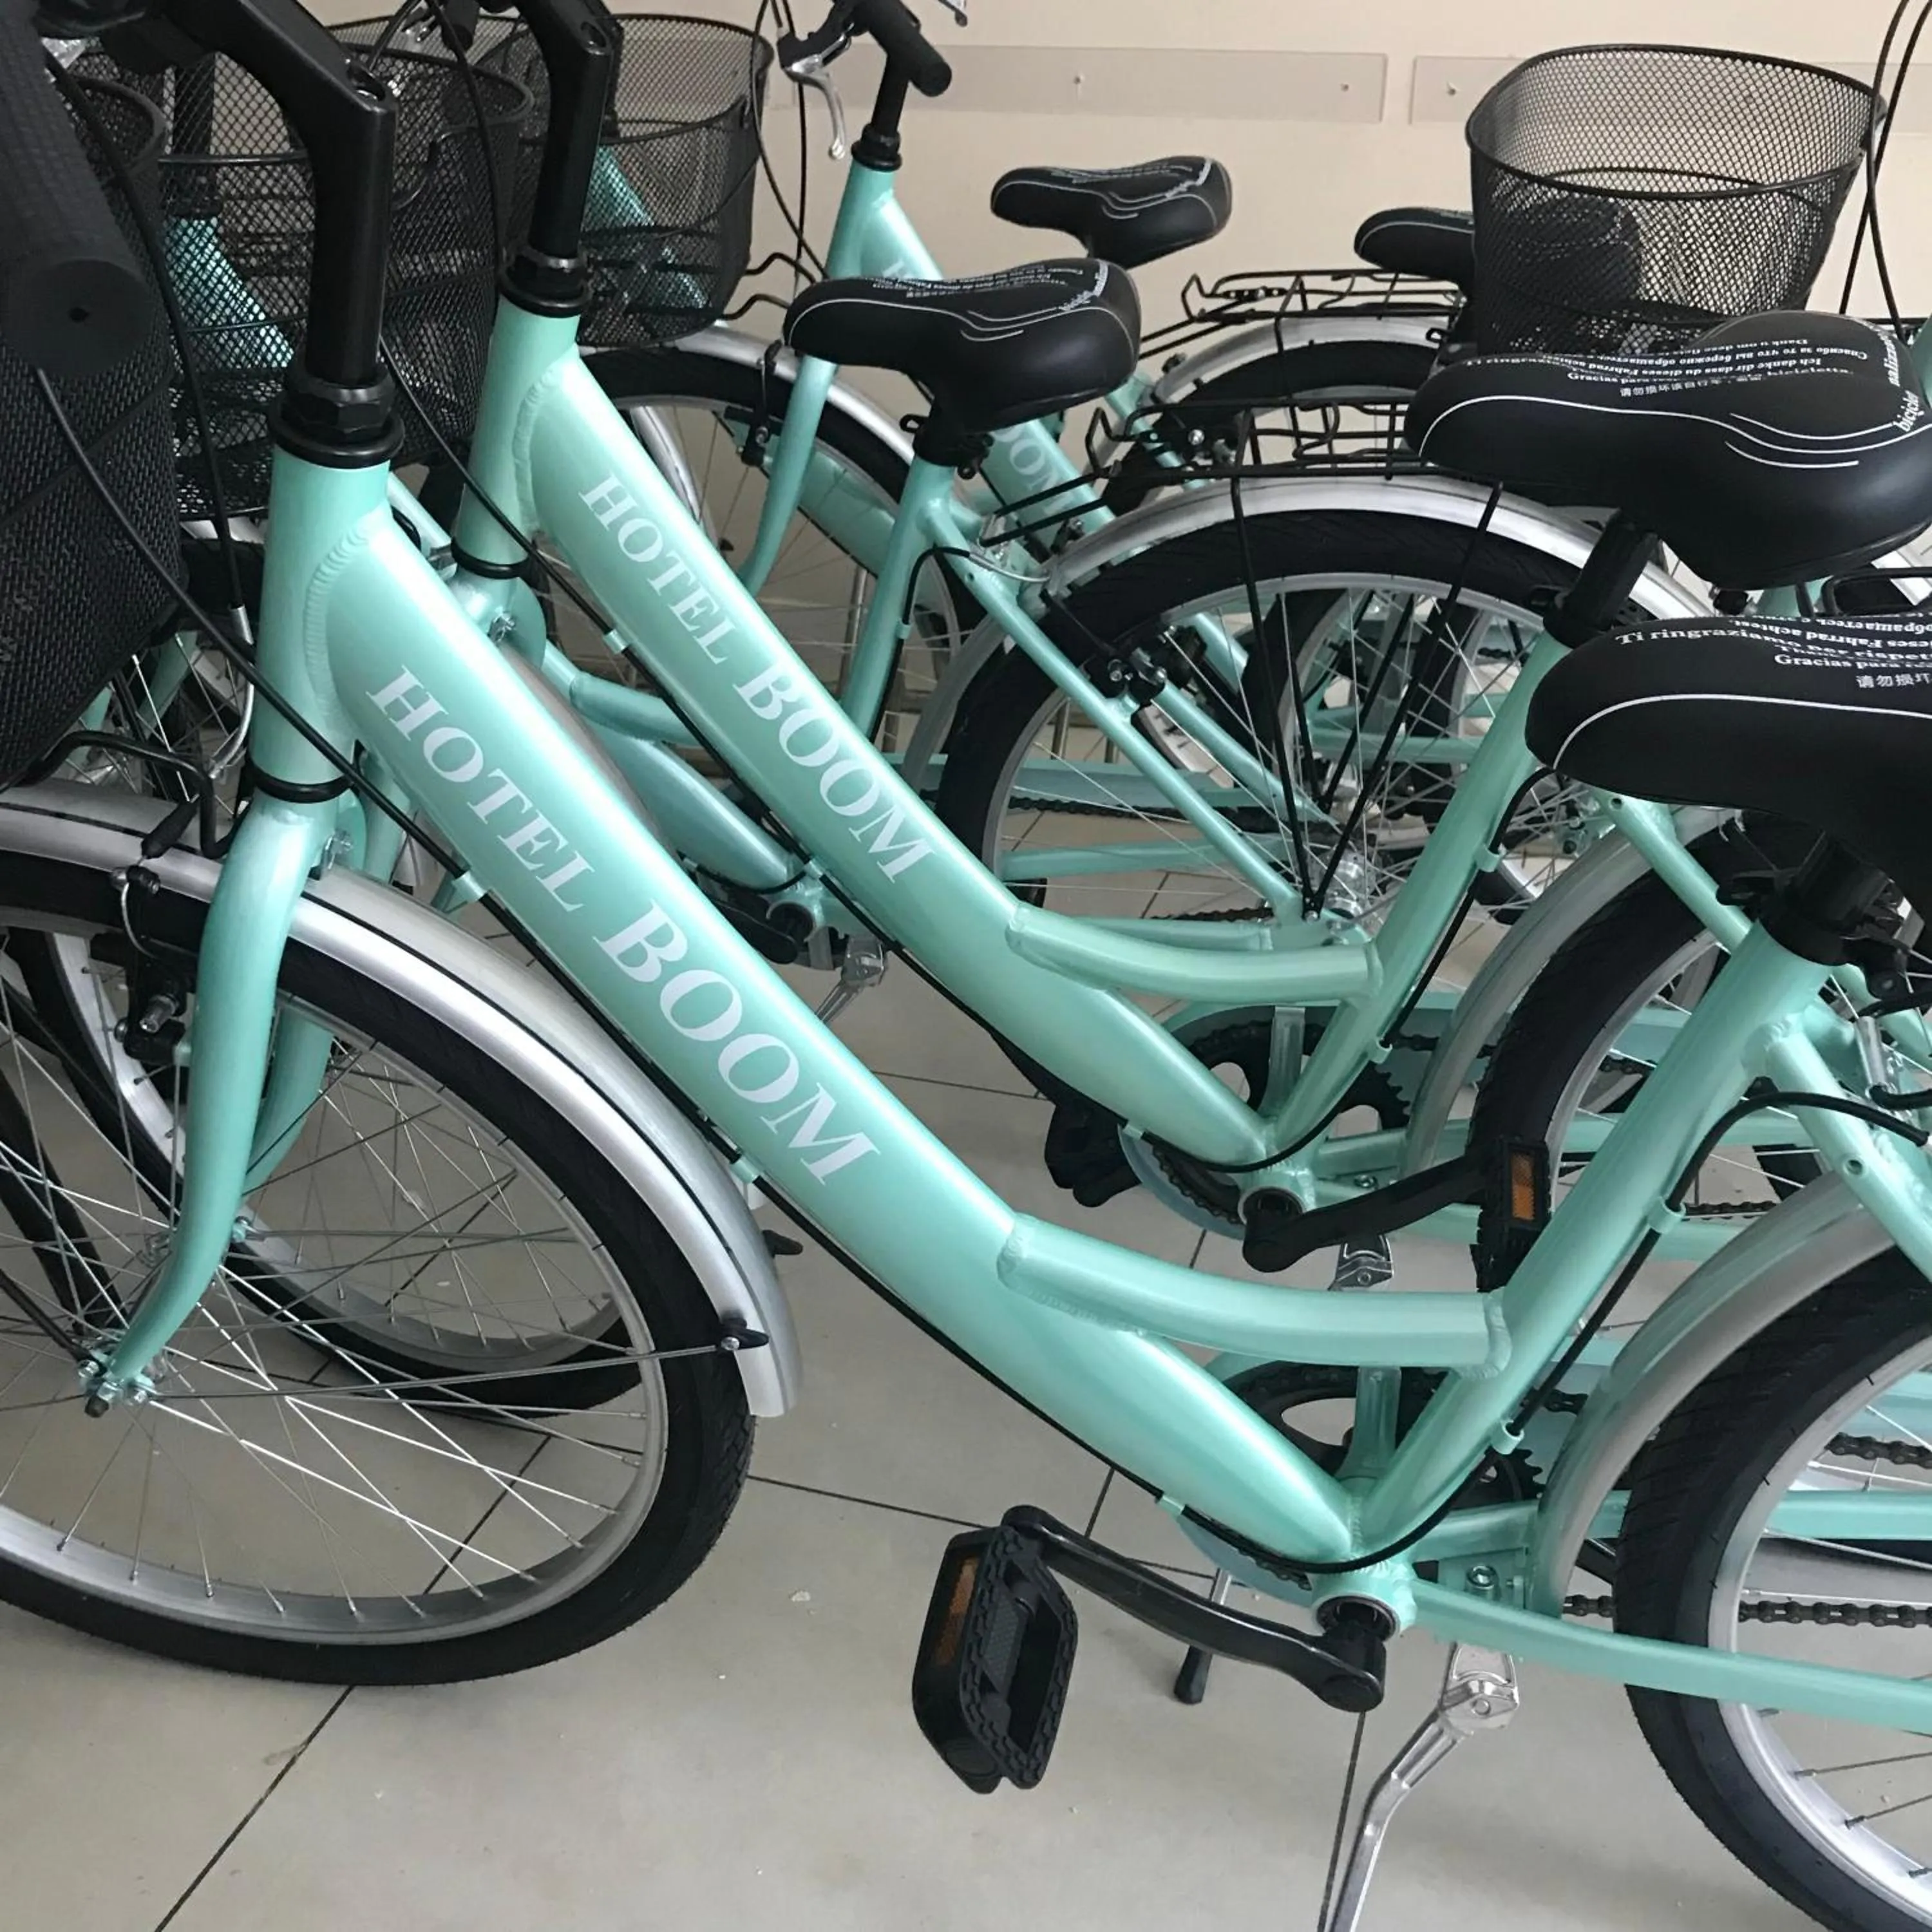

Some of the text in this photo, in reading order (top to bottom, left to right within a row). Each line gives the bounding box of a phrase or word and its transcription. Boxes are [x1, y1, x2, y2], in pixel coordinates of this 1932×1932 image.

[1816, 347, 1867, 360] Спасибо
[1589, 363, 1638, 375] Fahrrad
[1757, 359, 1797, 369] danke
[1567, 372, 1618, 383] Gracias
[1615, 631, 1644, 645] Ti
[1650, 629, 1801, 647] ringraziamo
[1806, 631, 1882, 649] Fahrrad
[1774, 654, 1852, 667] Gracias
[1855, 659, 1900, 669] para
[579, 471, 936, 884] HOTEL BOOM
[366, 665, 881, 1186] HOTEL BOOM
